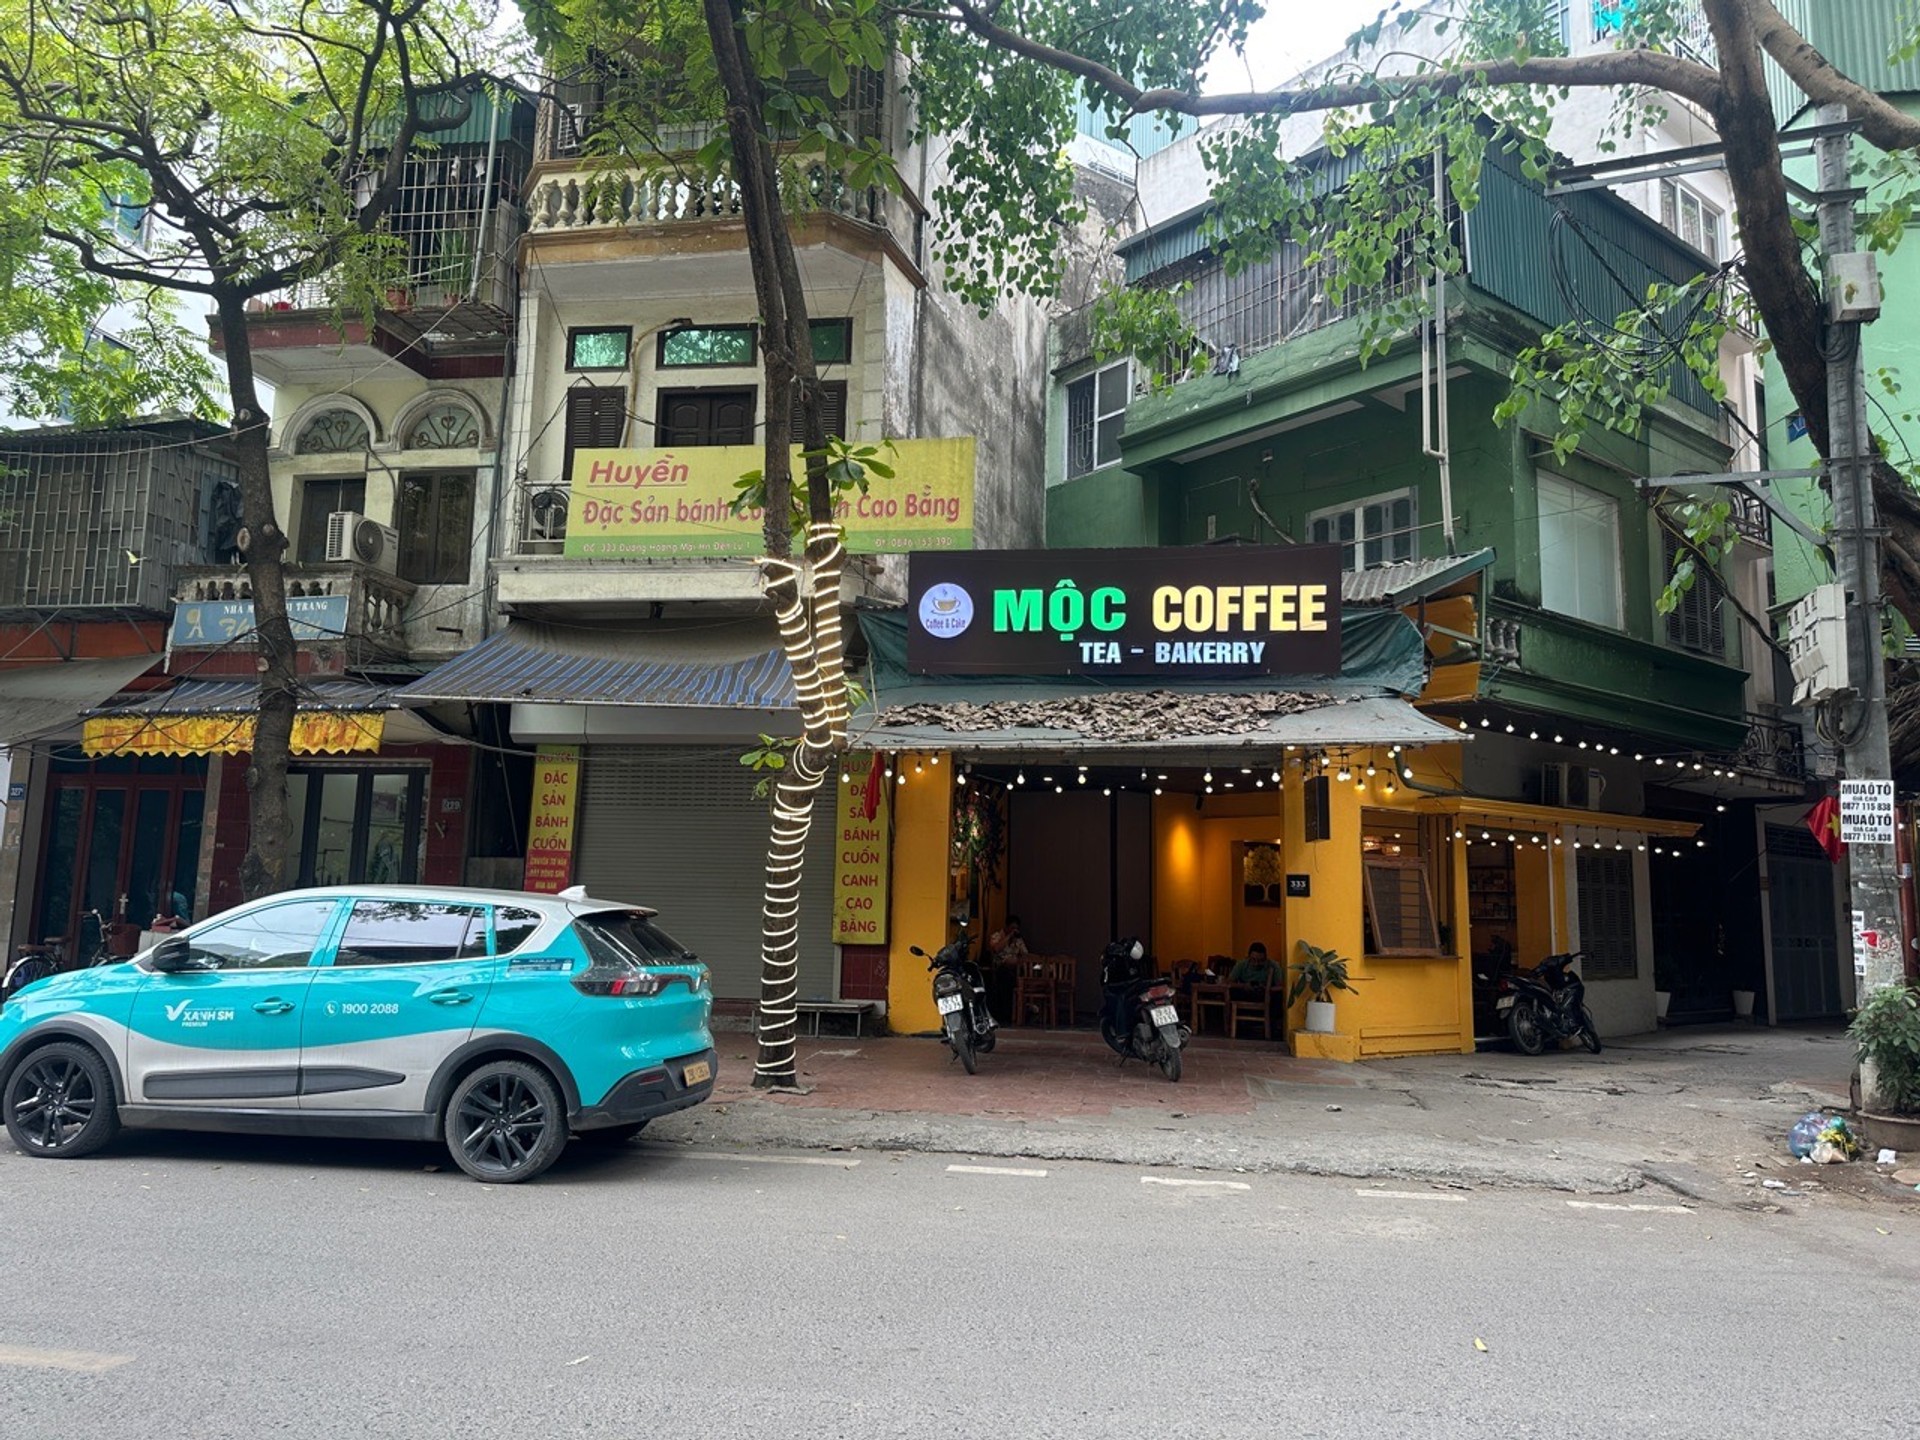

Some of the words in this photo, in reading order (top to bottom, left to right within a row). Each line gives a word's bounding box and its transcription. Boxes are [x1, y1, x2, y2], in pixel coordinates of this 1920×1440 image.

[589, 454, 689, 490] Huyền
[582, 499, 624, 530] Đặc
[629, 495, 669, 524] Sản
[676, 497, 729, 522] bánh
[857, 494, 897, 518] Cao
[905, 484, 960, 523] Bằng
[296, 602, 329, 612] TRANG
[993, 578, 1127, 642] MỘC
[1152, 585, 1328, 633] COFFEE
[926, 618, 944, 629] Coffee
[951, 618, 966, 628] Cake
[1079, 641, 1122, 665] TEA
[1155, 641, 1266, 664] BAKERRY
[544, 770, 569, 787] ĐẶC
[542, 790, 566, 806] SẢN
[1862, 803, 1876, 811] 115
[535, 812, 569, 828] BÁNH
[532, 832, 567, 850] CUỐN
[843, 826, 880, 842] BÁNH
[1863, 833, 1876, 841] 115
[842, 846, 880, 864] CUỐN
[841, 874, 879, 887] CANH
[1291, 880, 1306, 888] 333
[845, 896, 873, 910] CAO
[839, 913, 877, 933] BẰNG
[183, 1010, 216, 1021] XANH
[217, 1010, 235, 1021] SM
[342, 1003, 368, 1014] 1900
[370, 1003, 399, 1014] 2088
